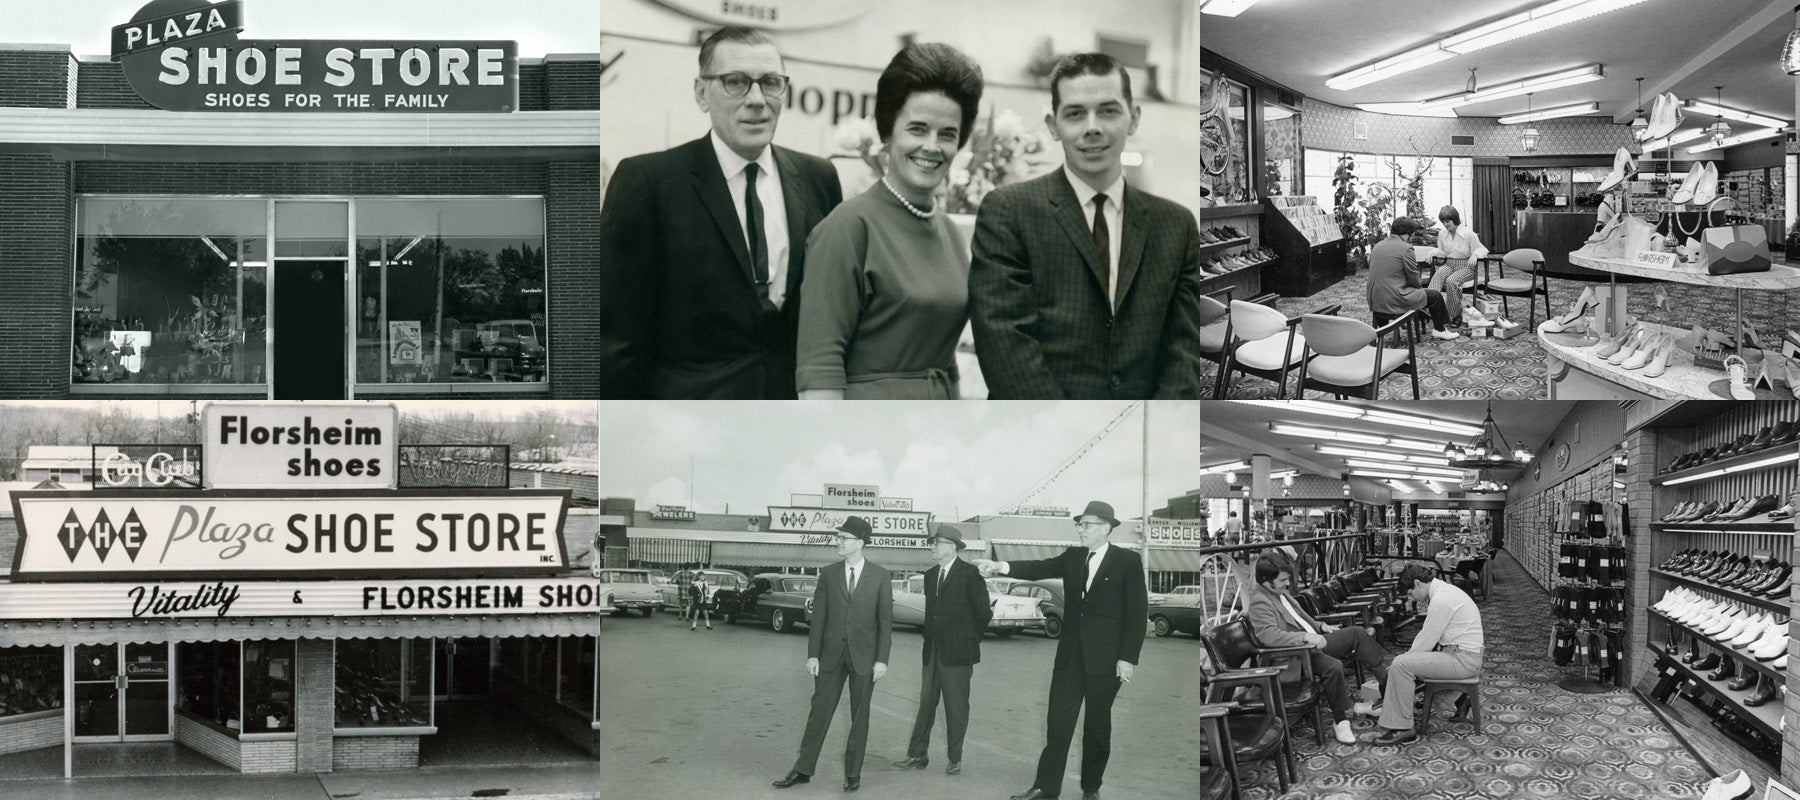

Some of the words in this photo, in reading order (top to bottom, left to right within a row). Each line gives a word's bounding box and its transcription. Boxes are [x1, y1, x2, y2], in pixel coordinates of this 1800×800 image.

[125, 9, 227, 49] PLAZA
[158, 47, 301, 86] SHOE
[324, 47, 505, 87] STORE
[204, 92, 271, 107] SHOES
[284, 93, 322, 107] FOR
[384, 93, 449, 108] FAMILY
[219, 415, 382, 446] Florsheim
[287, 446, 381, 477] shoes
[827, 487, 876, 498] Florsheim
[846, 498, 876, 507] shoes
[782, 515, 806, 524] THE
[810, 512, 843, 529] Plaza
[885, 517, 924, 530] STORE
[1151, 527, 1200, 539] SHOES
[63, 523, 142, 548] THE
[159, 505, 274, 564] Plaza
[285, 512, 394, 553] SHOE
[416, 512, 547, 552] STORE
[800, 534, 834, 545] Vitality
[127, 581, 241, 618] Vitality
[292, 590, 303, 604] &
[363, 585, 524, 610] FLORSHEIM
